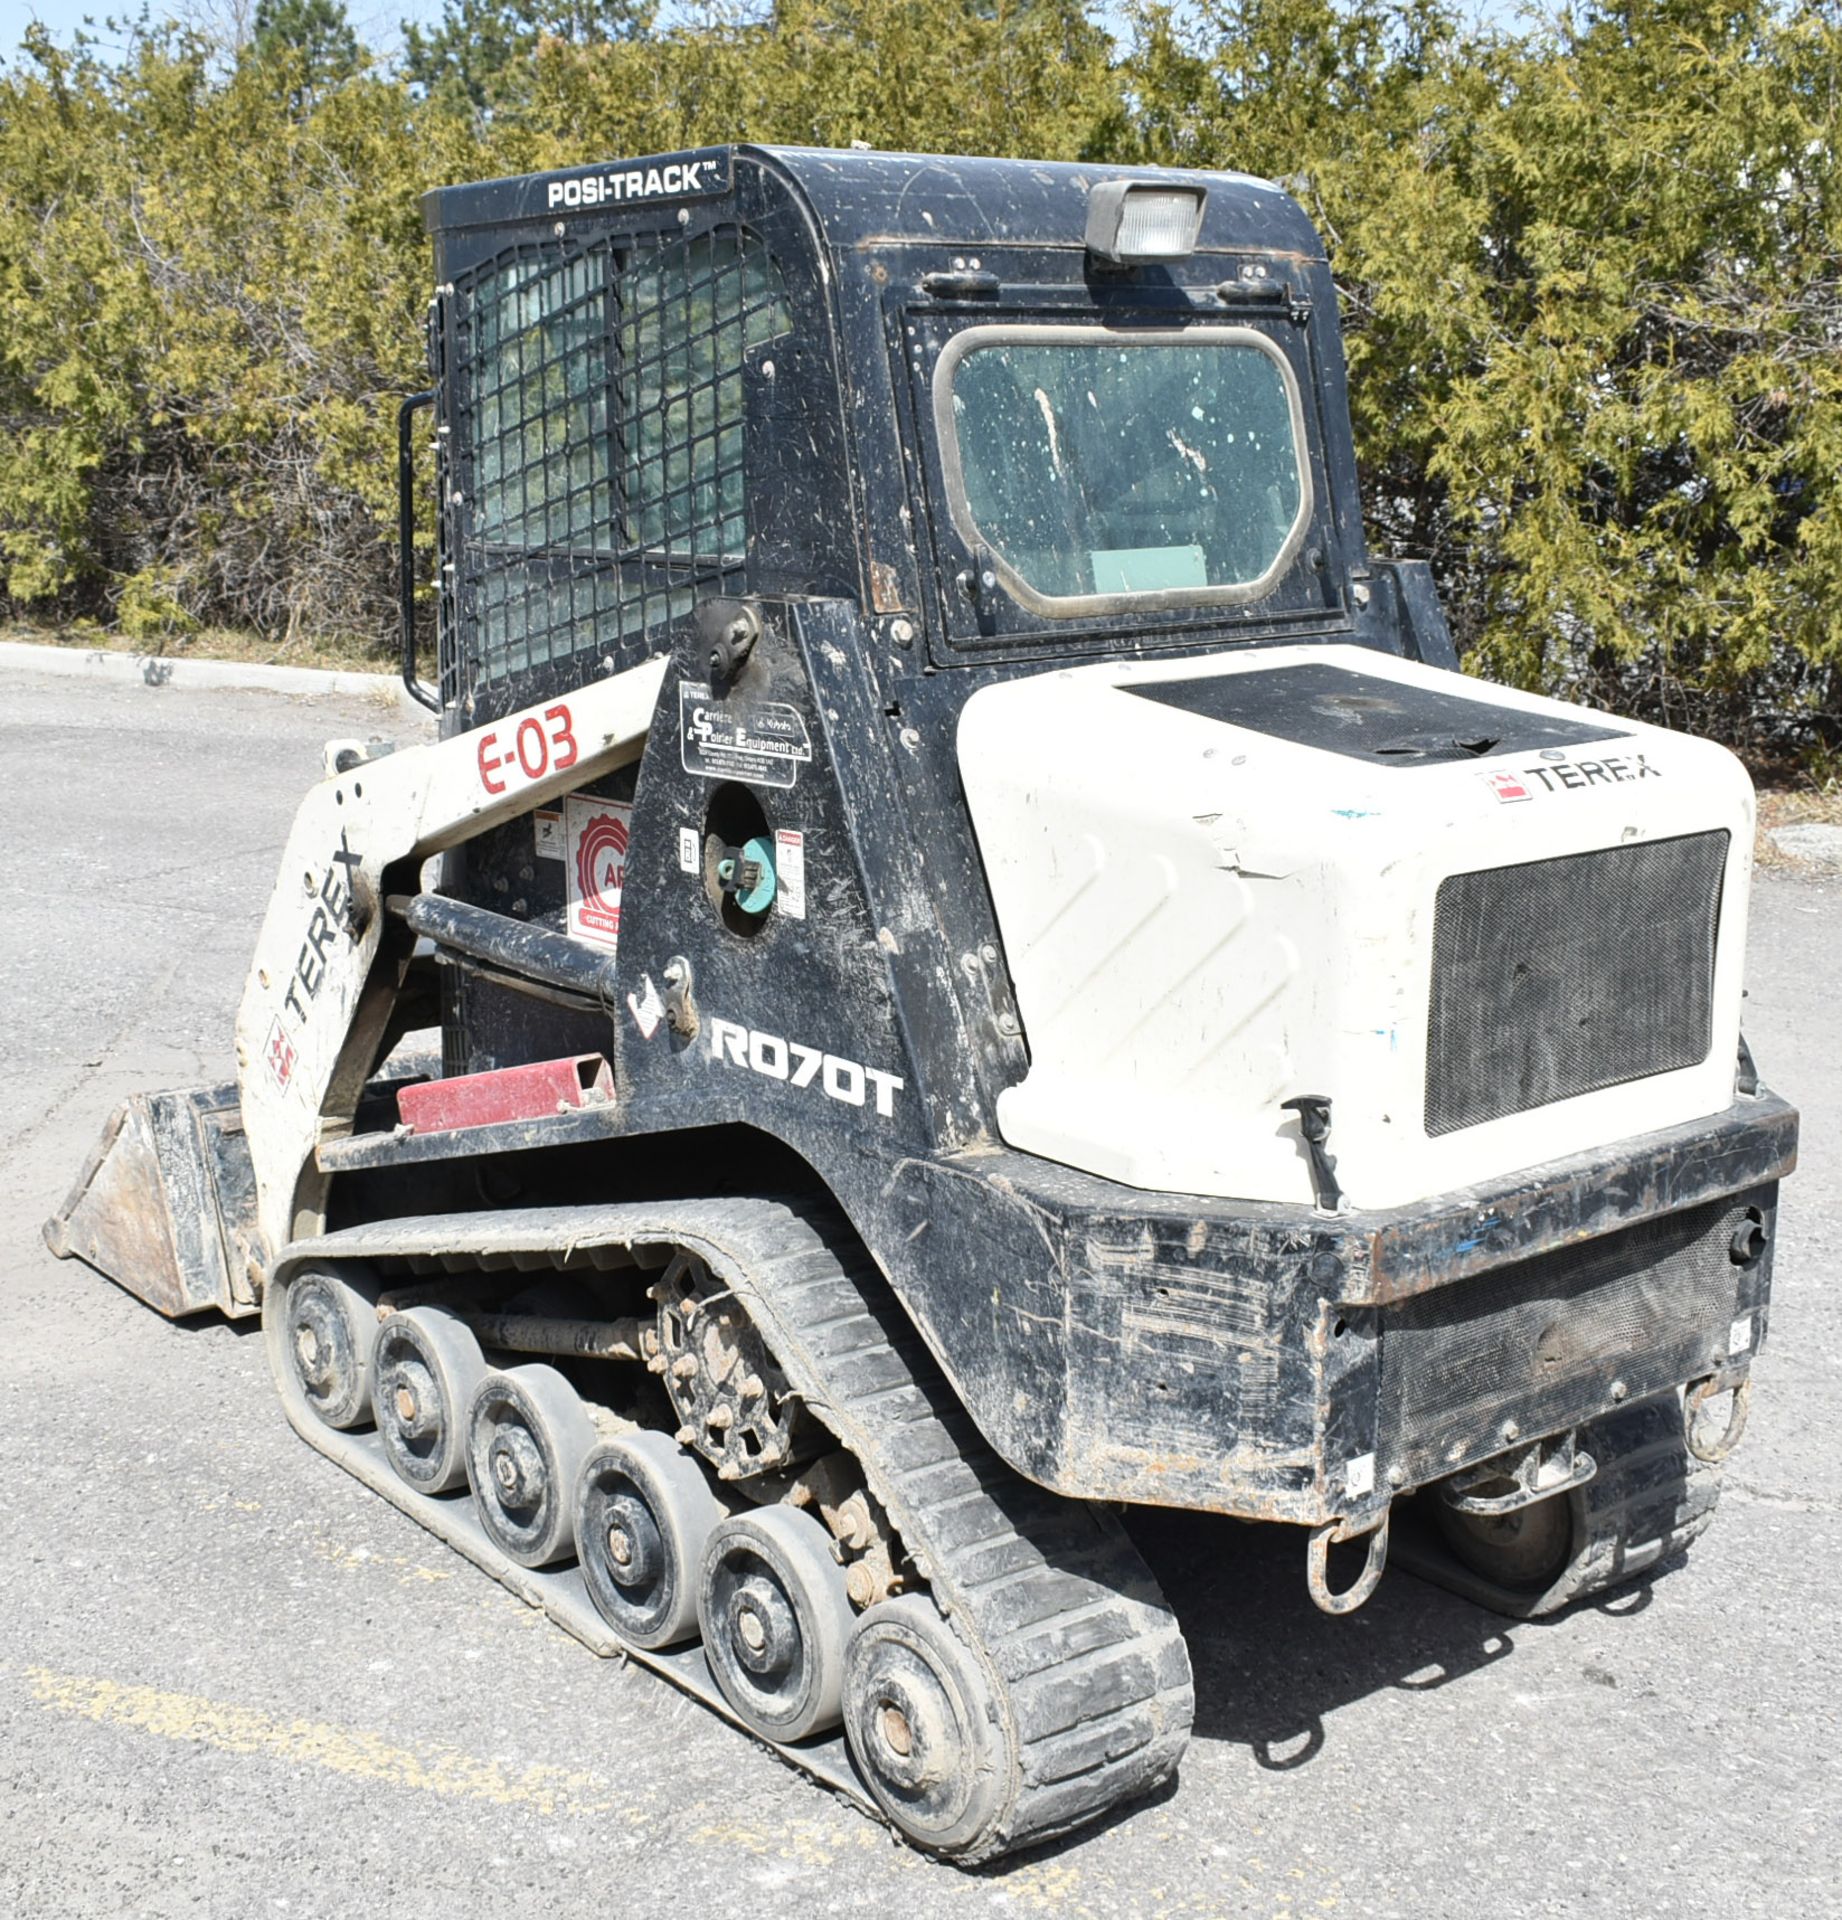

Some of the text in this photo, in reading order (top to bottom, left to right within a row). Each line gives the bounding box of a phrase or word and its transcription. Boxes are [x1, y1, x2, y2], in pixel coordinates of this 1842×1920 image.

[478, 704, 578, 795] E-03
[736, 727, 790, 752] Equipment
[1524, 754, 1662, 792] TEREX
[284, 825, 363, 1024] TEREX
